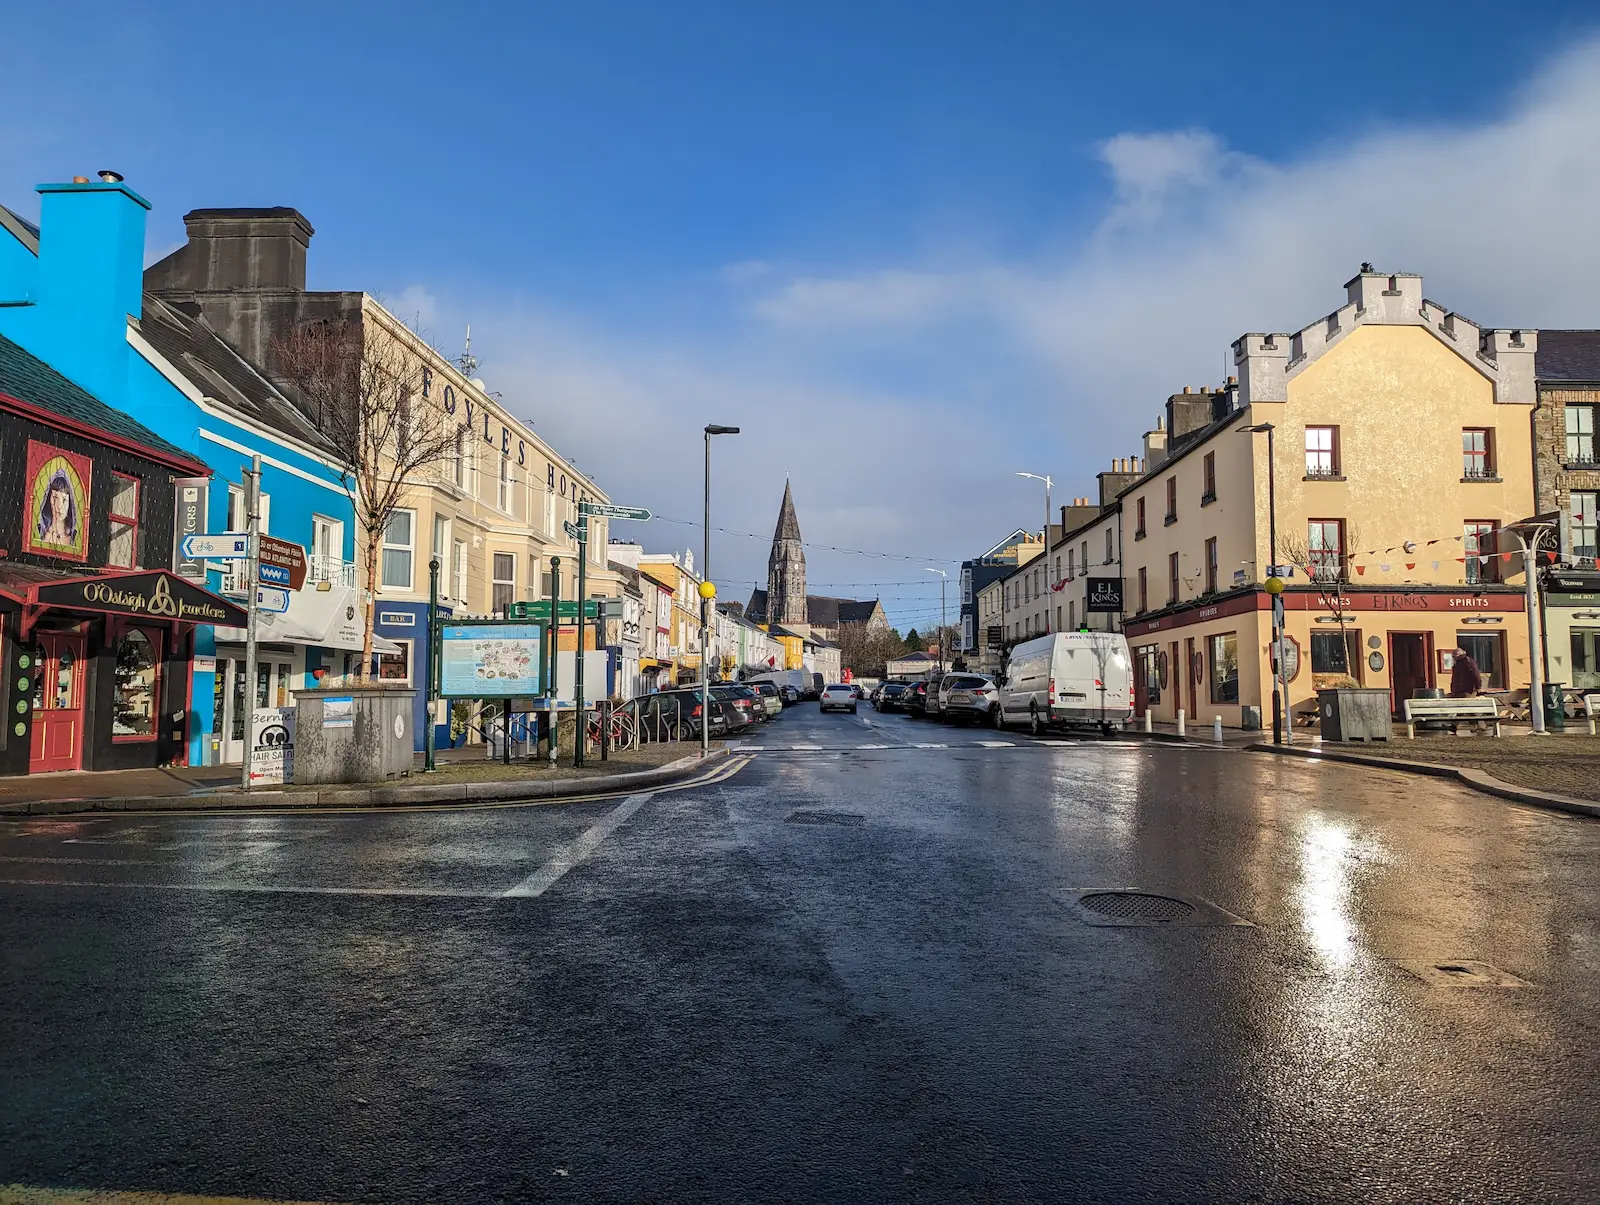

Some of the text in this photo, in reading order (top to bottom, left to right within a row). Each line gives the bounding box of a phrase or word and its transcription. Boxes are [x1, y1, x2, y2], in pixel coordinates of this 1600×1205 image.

[422, 366, 525, 465] FOYLE'S
[1098, 583, 1113, 594] E.J.
[1091, 593, 1120, 603] KINGS
[1318, 597, 1350, 606] WINES
[1392, 596, 1428, 609] KINGS
[1450, 598, 1489, 607] SPIRITS
[178, 598, 225, 619] Jewellers
[1200, 607, 1217, 617] SPIRITS
